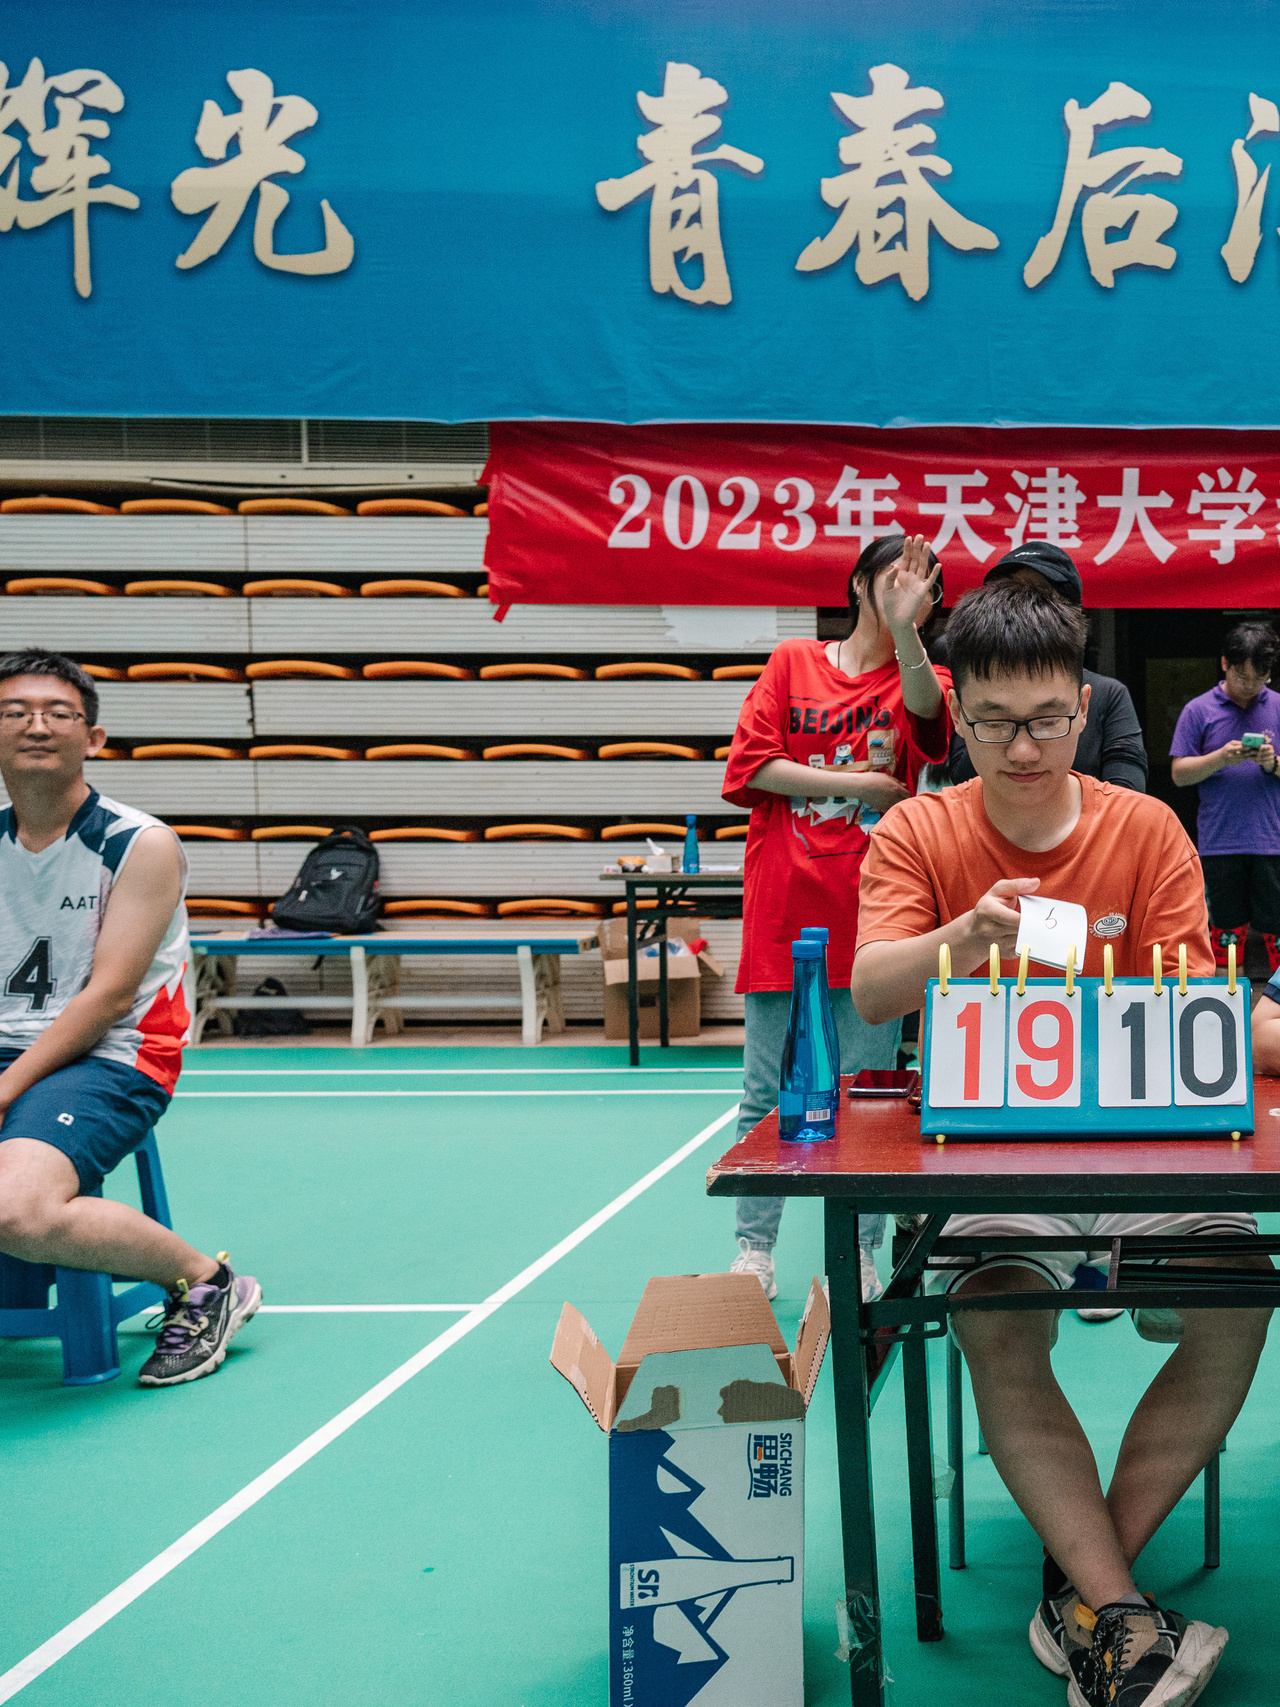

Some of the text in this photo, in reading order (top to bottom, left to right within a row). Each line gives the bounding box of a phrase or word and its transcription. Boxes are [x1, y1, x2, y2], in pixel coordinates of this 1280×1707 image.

[788, 706, 891, 735] BEIJING
[60, 896, 97, 910] AAT
[4, 936, 58, 1013] 4
[753, 1434, 780, 1498] 思畅
